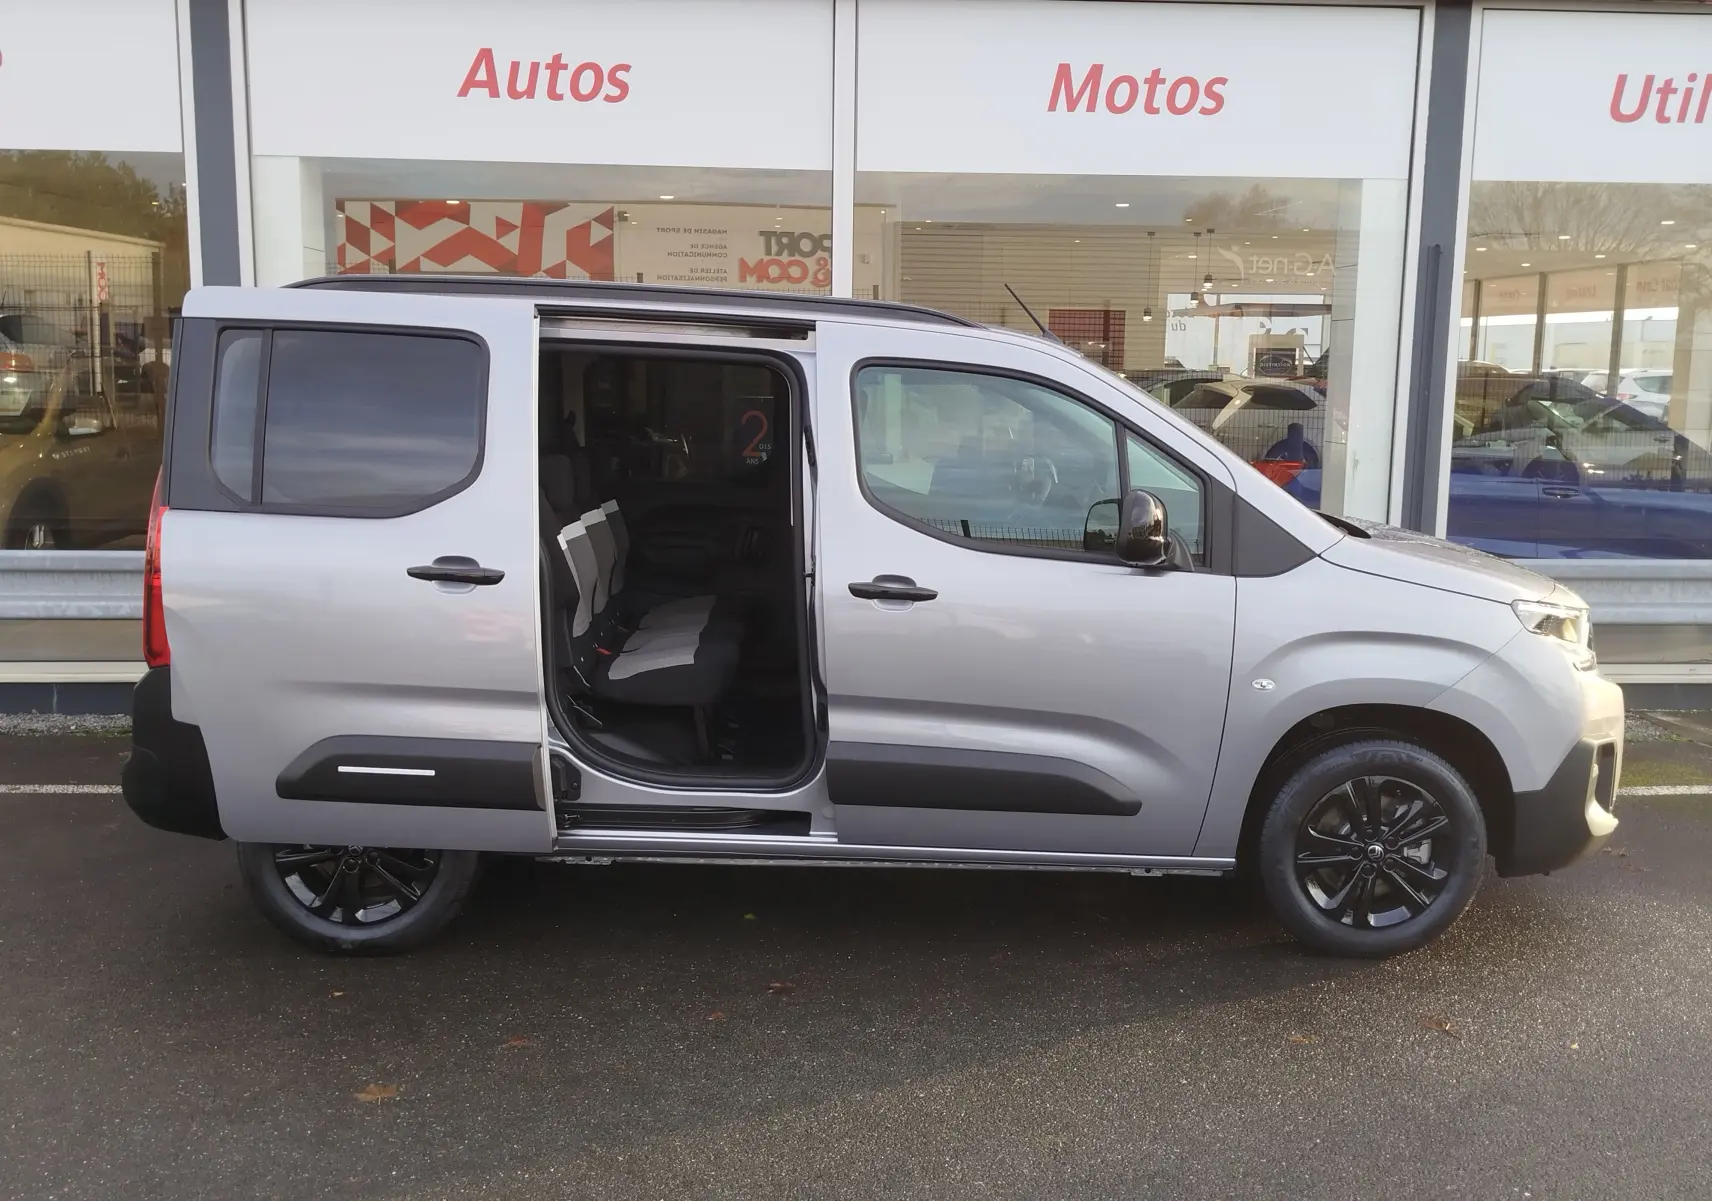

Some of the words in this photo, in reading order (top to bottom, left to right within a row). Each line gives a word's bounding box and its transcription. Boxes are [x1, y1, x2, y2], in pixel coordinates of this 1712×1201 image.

[457, 47, 632, 103] Autos
[1047, 63, 1229, 116] Motos
[1610, 72, 1712, 124] Util
[742, 410, 768, 456] 2
